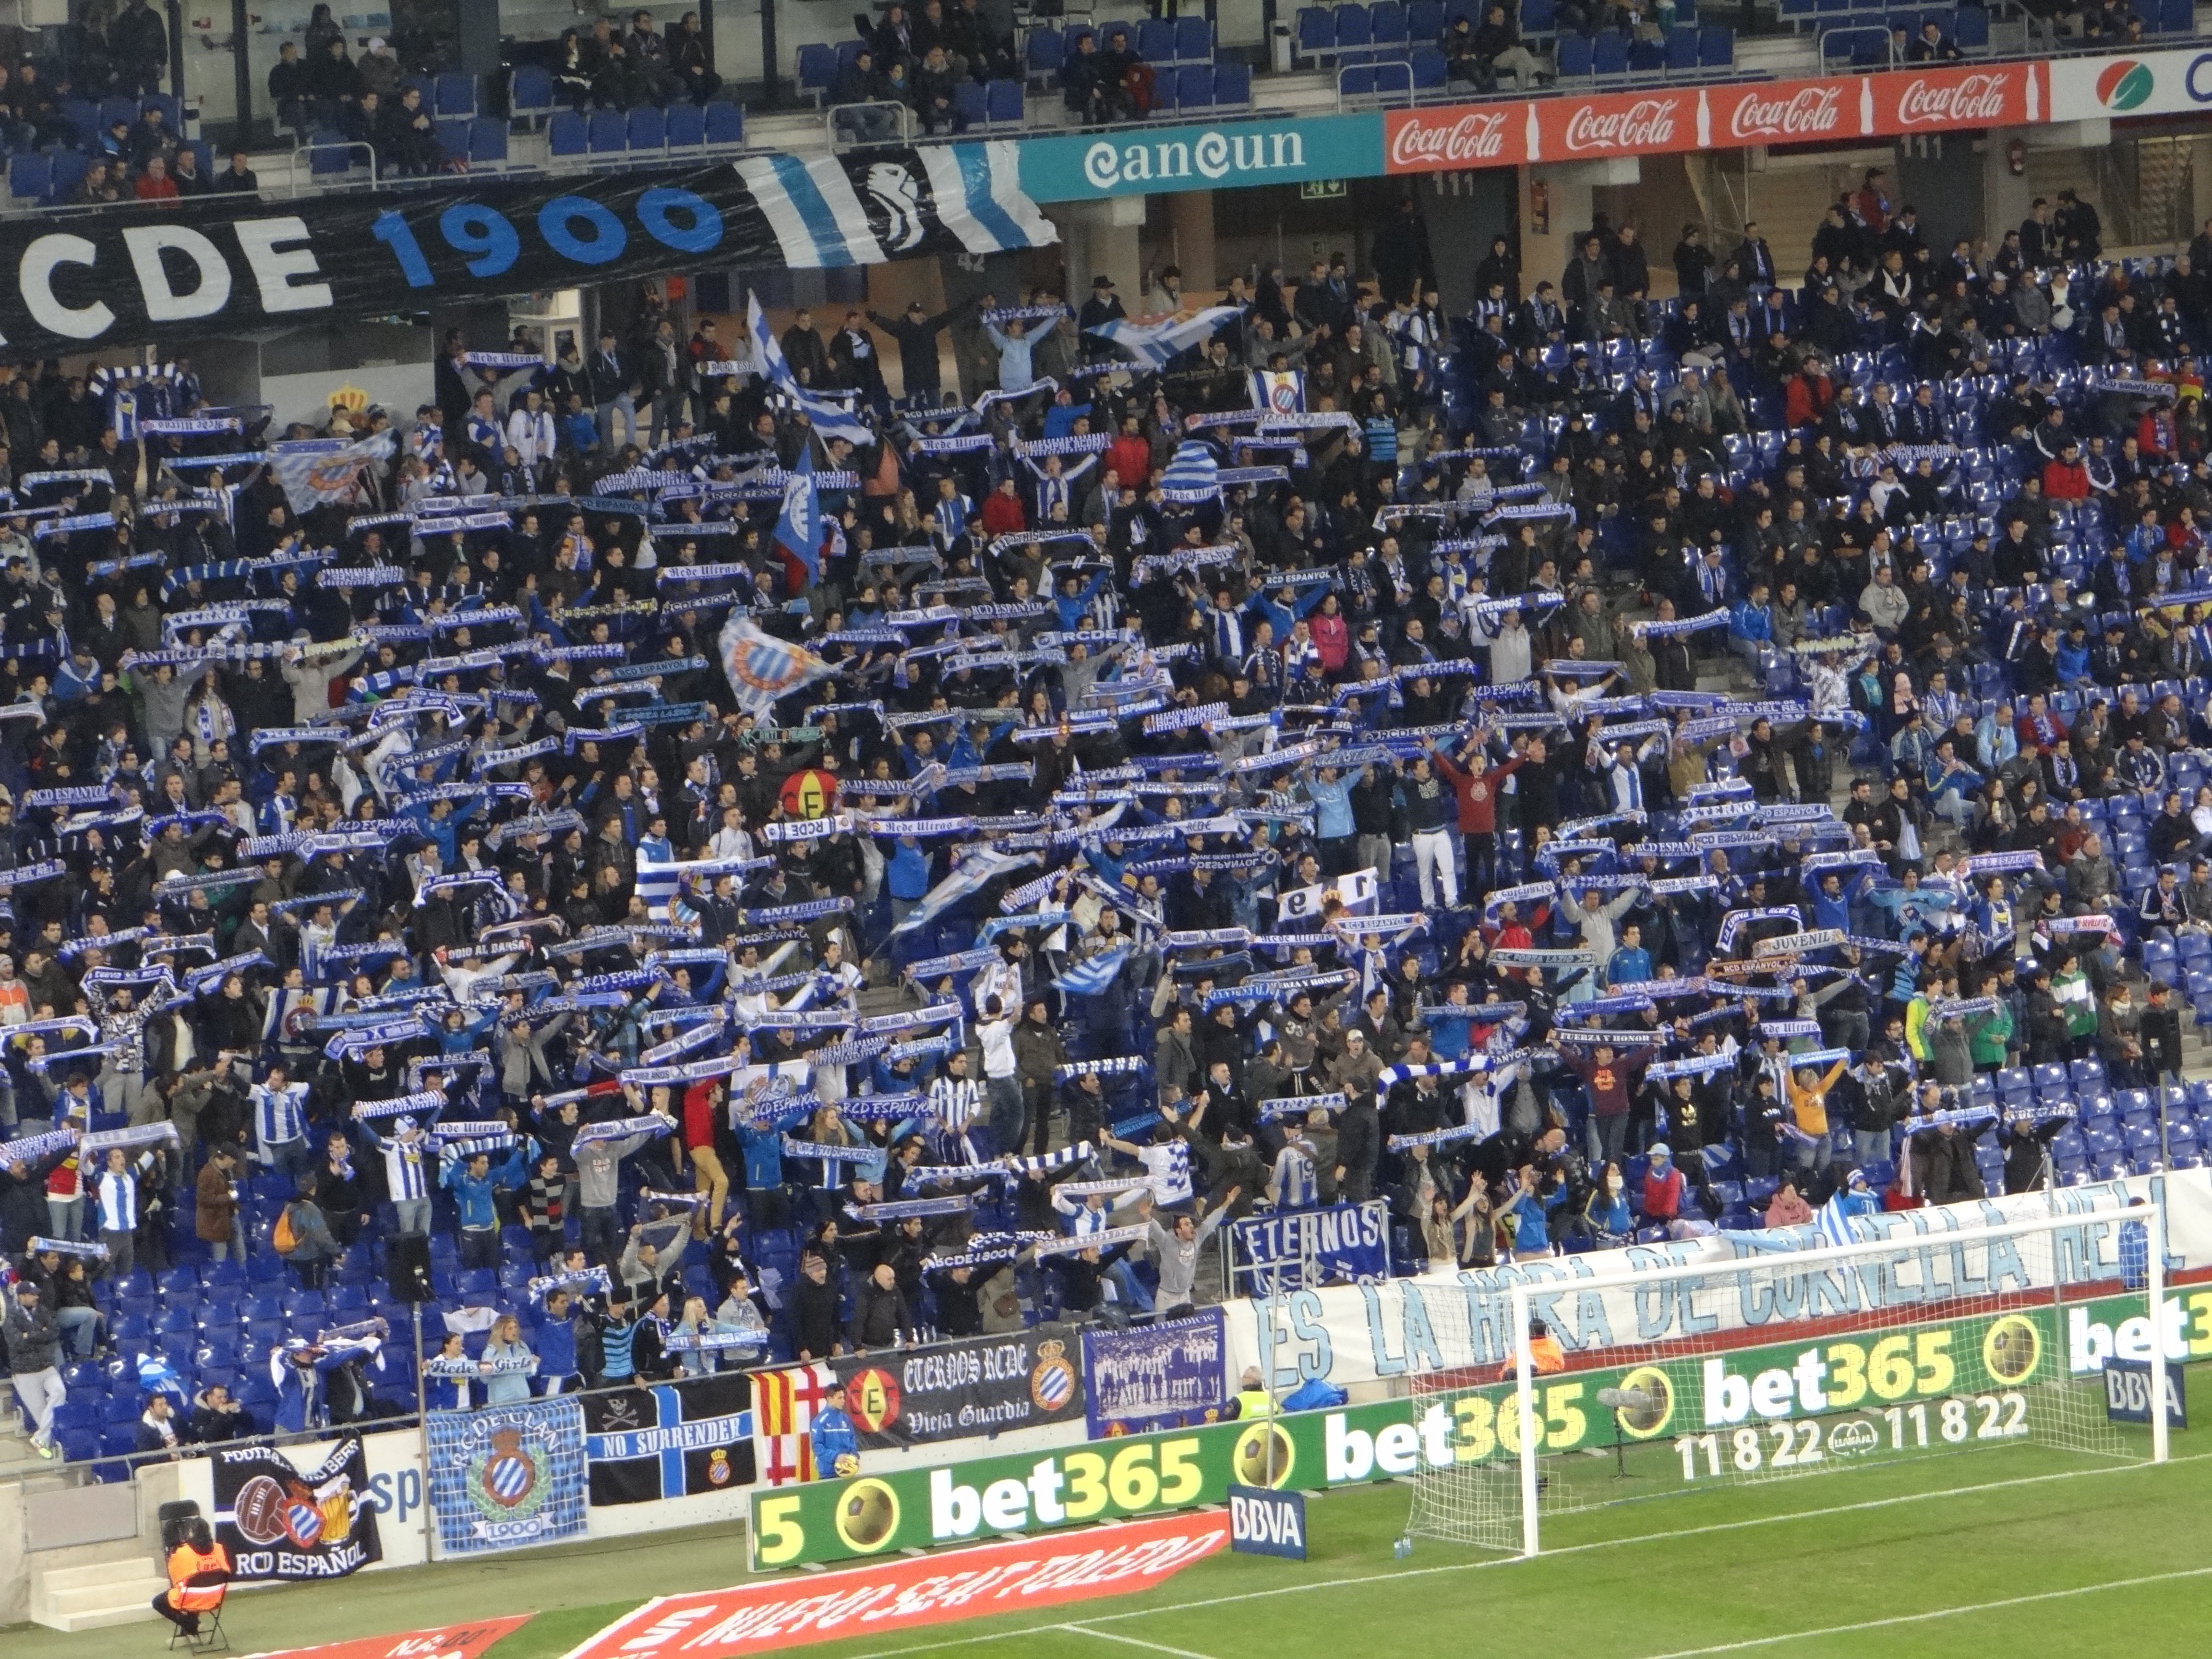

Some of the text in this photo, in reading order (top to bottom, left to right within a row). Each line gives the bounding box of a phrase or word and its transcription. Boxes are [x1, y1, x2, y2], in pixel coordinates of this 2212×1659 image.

[1899, 73, 2008, 124] Coca-Cola
[1731, 85, 1842, 138] Coca-Cola
[1566, 97, 1679, 151] Coca-Cola
[1392, 111, 1508, 165] Coca-Cola
[1901, 134, 1941, 159] 111
[1083, 131, 1306, 188] CanCun
[371, 187, 723, 288] 1900
[1267, 570, 1331, 584] RCD ESPANYOL
[1477, 597, 1522, 613] ETERNOS
[434, 612, 459, 624] RCD
[1062, 629, 1113, 641] RCDE
[1252, 750, 1286, 764] ESPANYOL
[1774, 805, 1816, 817] ESPANYOL
[791, 821, 823, 837] RCDE
[916, 820, 953, 831] Ultras
[1345, 917, 1406, 930] RCD ESPANYOL
[474, 945, 489, 956] AL
[1772, 932, 1831, 952] JUVENIL
[1723, 960, 1781, 973] RCD ESPANYOL
[584, 975, 608, 987] RCD
[1310, 974, 1344, 986] HONOR
[1560, 1032, 1600, 1041] FUERZA
[1612, 1033, 1650, 1041] HONOR
[1784, 1022, 1818, 1033] Ultras
[755, 1092, 815, 1116] RCD ESPANYOL
[844, 1102, 870, 1115] RCD
[464, 1122, 504, 1132] Ultras
[1245, 1204, 1381, 1263] ETERNOS
[1250, 1289, 1334, 1389] ES
[1358, 1279, 1444, 1376] LA
[1457, 1255, 1615, 1364] HORA
[1625, 1237, 1719, 1340] DE
[903, 1350, 981, 1393] ETERNOS
[1704, 1329, 1955, 1425] bet365
[907, 1398, 1030, 1435] Vieja Guardia
[509, 1411, 562, 1453] CLAN
[603, 1416, 741, 1457] NO SURRENDER
[1325, 1382, 1587, 1483] bet365
[931, 1437, 1202, 1539] bet365
[489, 1519, 539, 1537] 1900
[1231, 1496, 1302, 1548] BBVA
[236, 1541, 368, 1576] RCD ESPAÑOL
[682, 1587, 892, 1649] NUEVO
